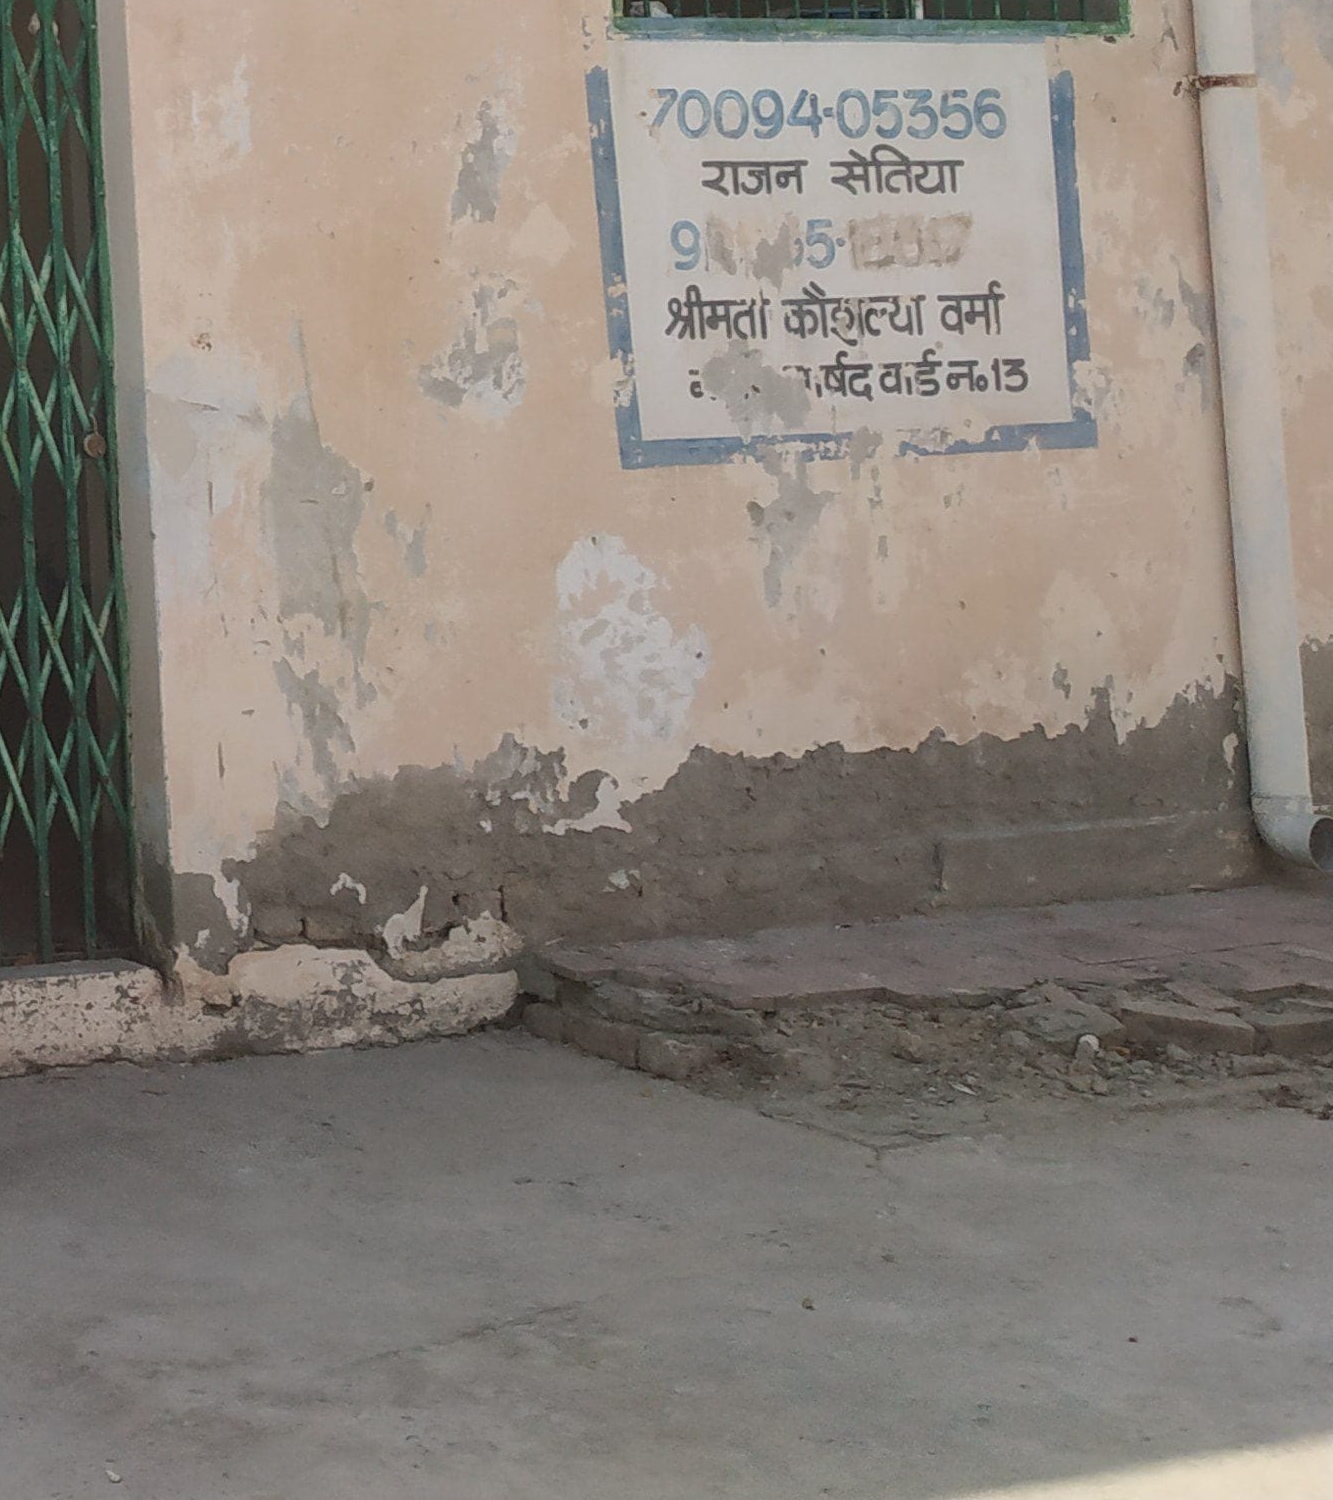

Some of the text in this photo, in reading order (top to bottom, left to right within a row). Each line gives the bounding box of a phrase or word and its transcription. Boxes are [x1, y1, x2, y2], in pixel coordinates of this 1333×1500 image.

[649, 88, 1007, 139] 70094-05356
[701, 144, 965, 197] राजन सेतिया
[937, 280, 1006, 335] वर्मा
